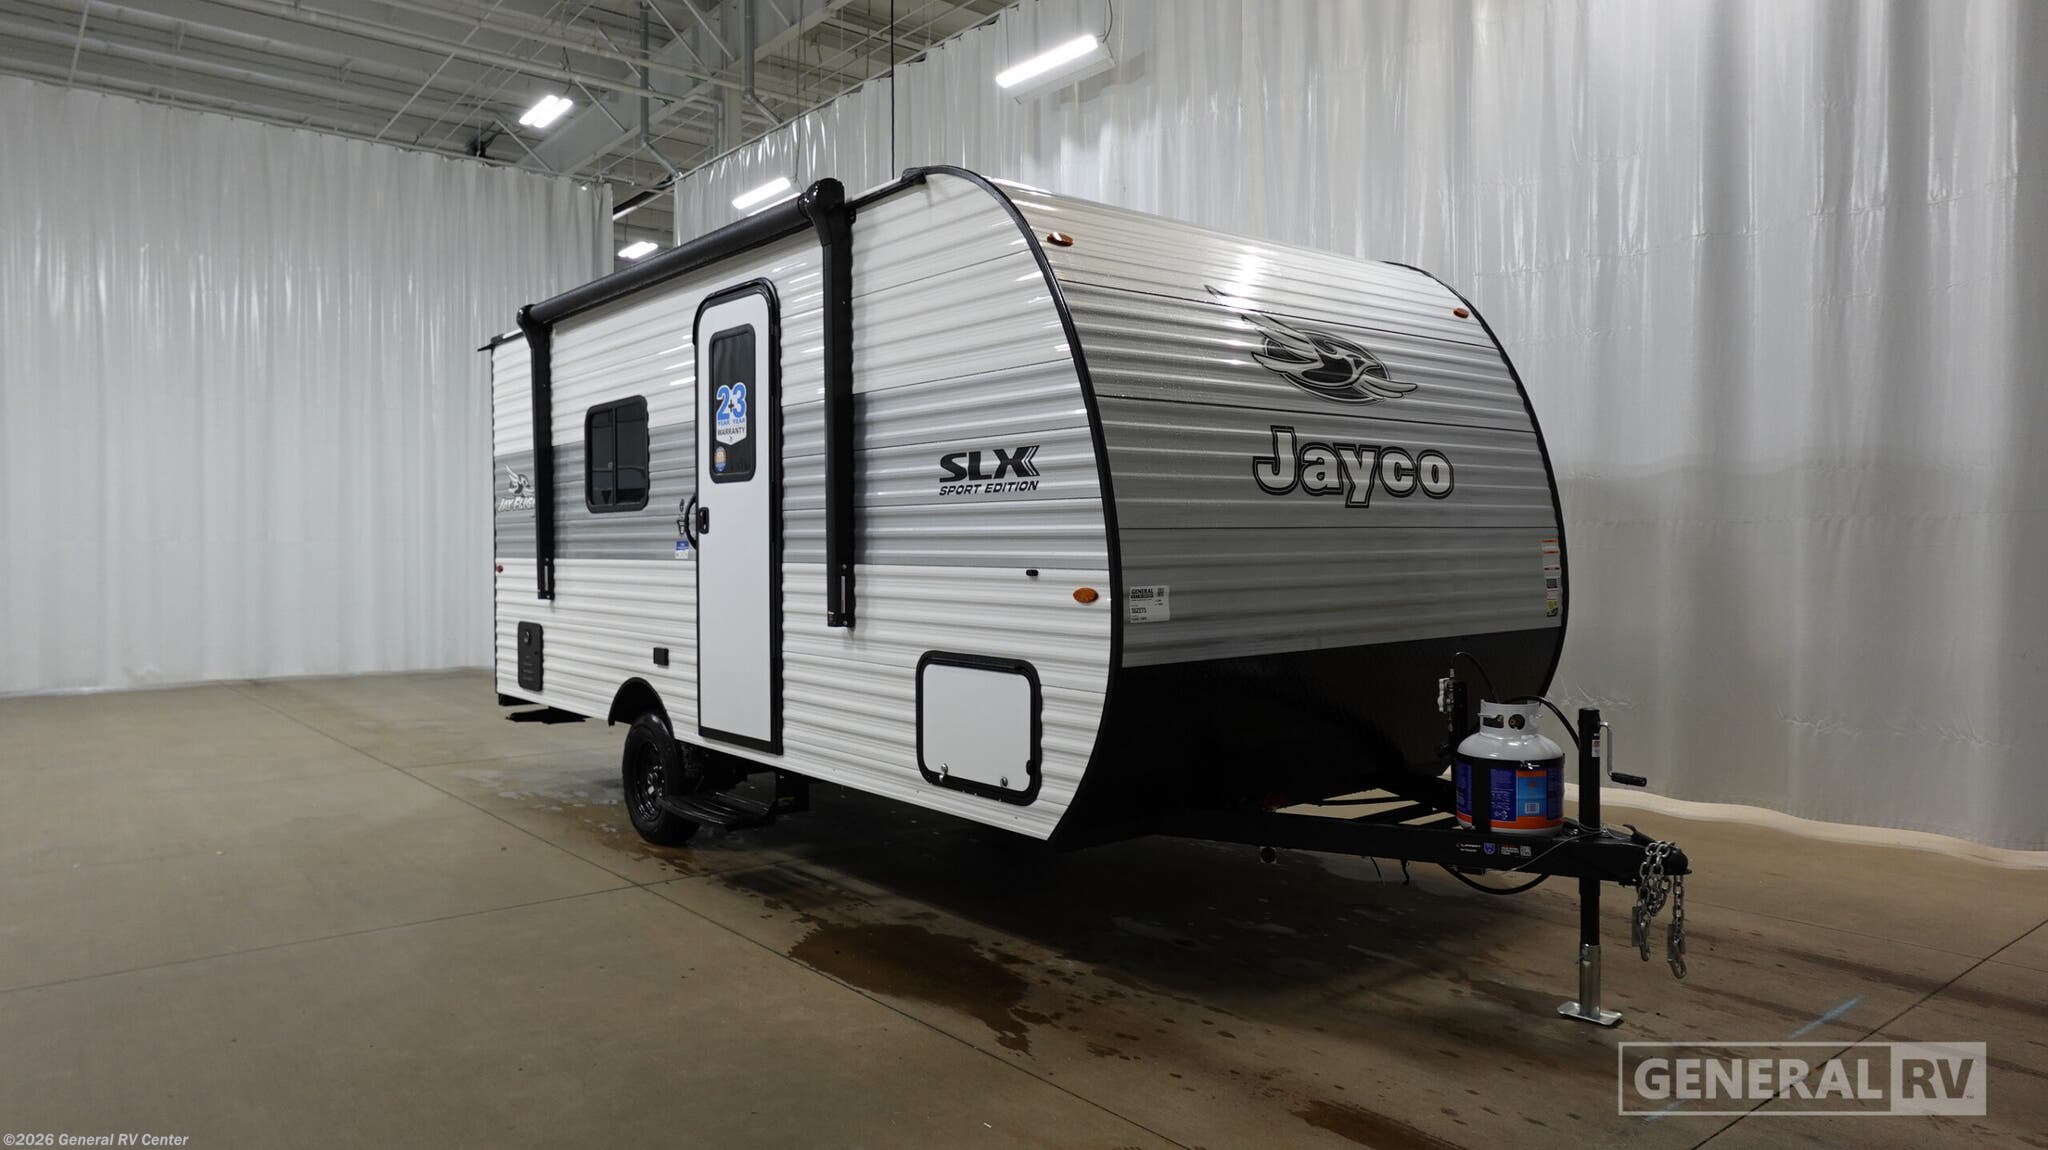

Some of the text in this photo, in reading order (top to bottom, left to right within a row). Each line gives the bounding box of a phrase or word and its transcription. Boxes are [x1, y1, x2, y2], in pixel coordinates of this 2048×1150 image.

[718, 427, 745, 436] WARRANTY
[939, 445, 1040, 483] SLX
[1253, 425, 1454, 508] Jayco
[939, 480, 1039, 496] SPORT EDITION
[497, 498, 514, 512] JAY
